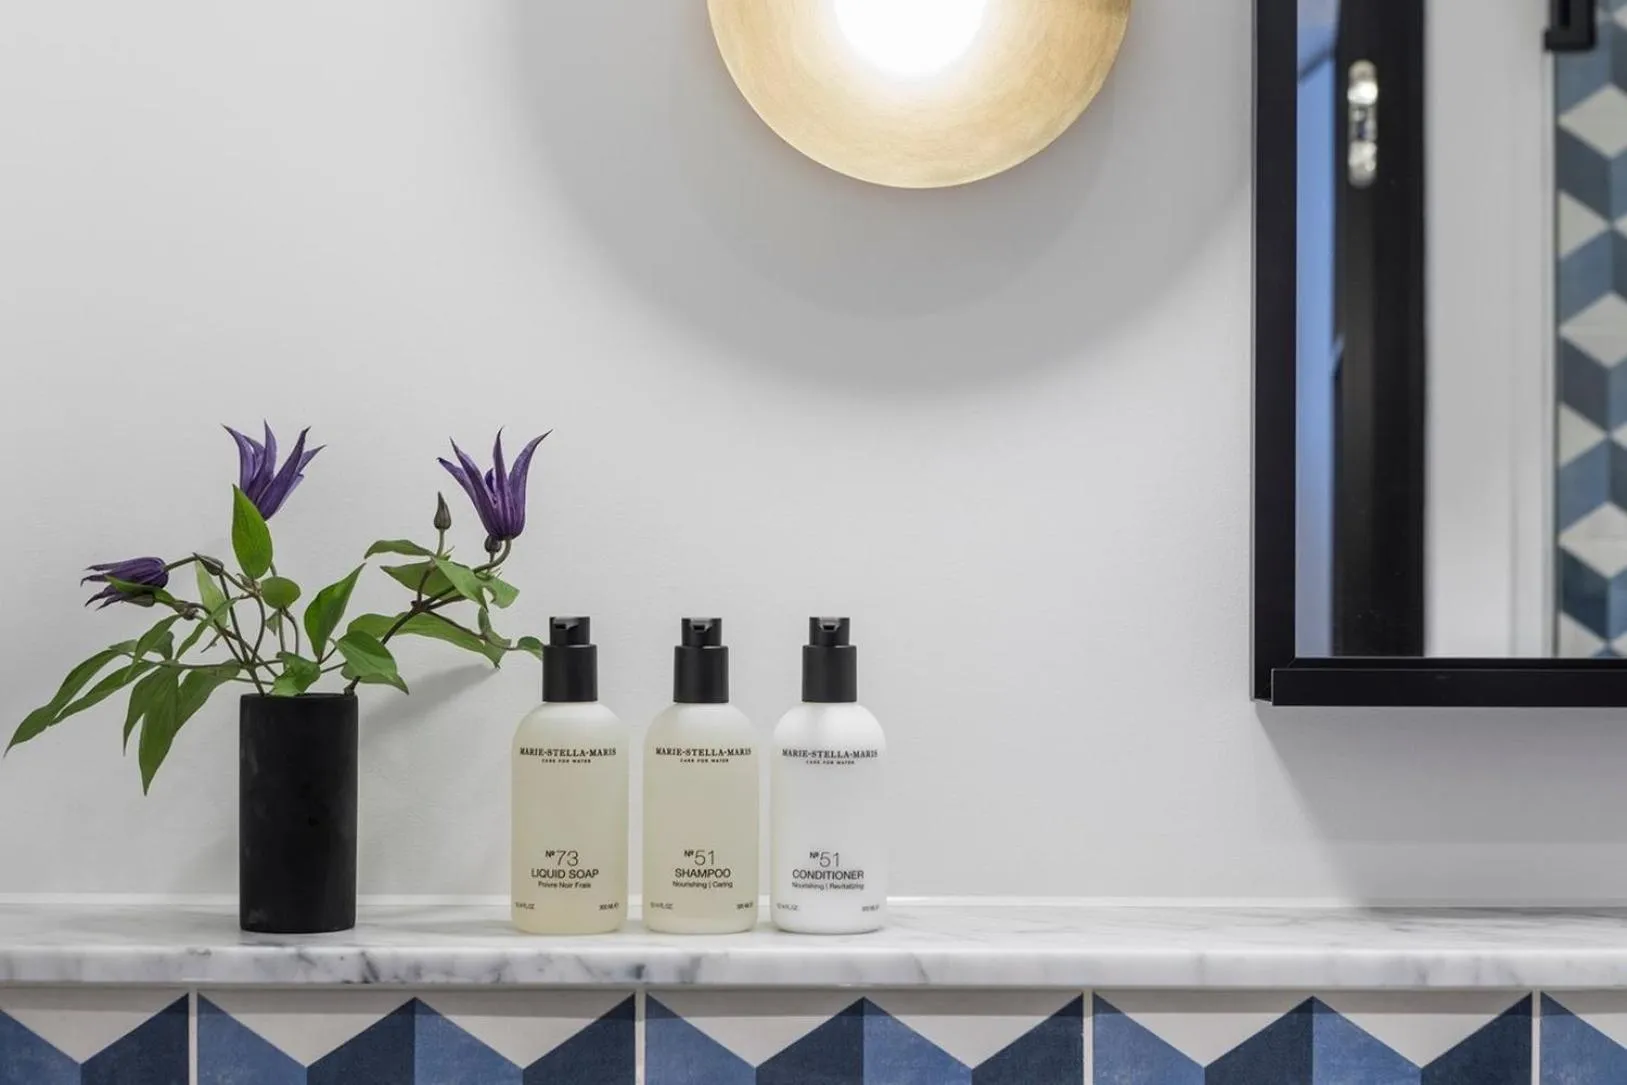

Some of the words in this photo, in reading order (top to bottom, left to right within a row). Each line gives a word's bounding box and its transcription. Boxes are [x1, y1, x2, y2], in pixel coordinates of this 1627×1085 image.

[531, 868, 566, 879] LIQUID
[568, 869, 599, 879] SOAP
[674, 868, 731, 878] SHAMPOO
[792, 869, 865, 880] CONDITIONER
[672, 881, 708, 889] Nourishing
